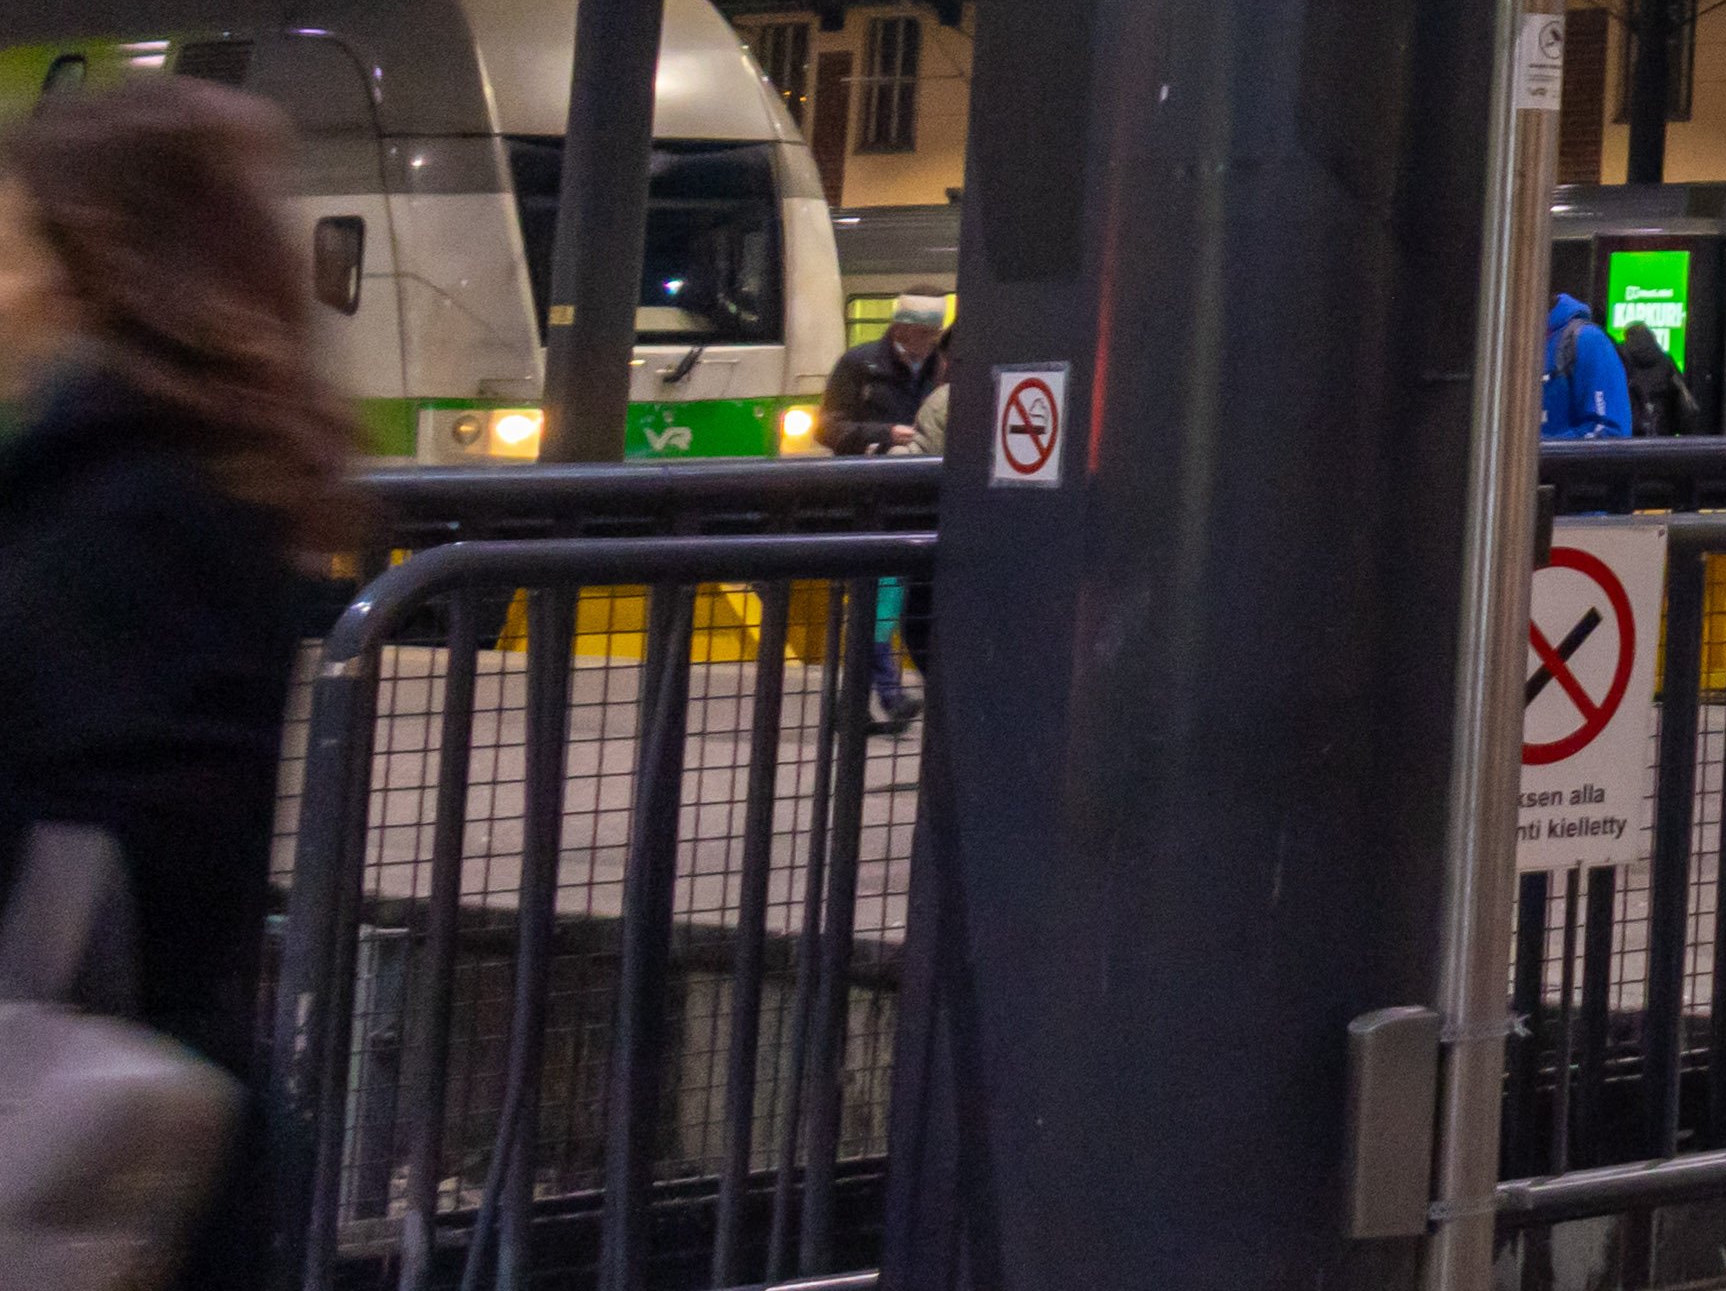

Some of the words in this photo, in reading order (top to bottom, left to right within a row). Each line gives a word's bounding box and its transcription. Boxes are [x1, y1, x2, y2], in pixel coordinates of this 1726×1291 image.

[644, 427, 693, 451] VR
[1569, 784, 1605, 805] alla
[1548, 817, 1627, 839] kielletty
